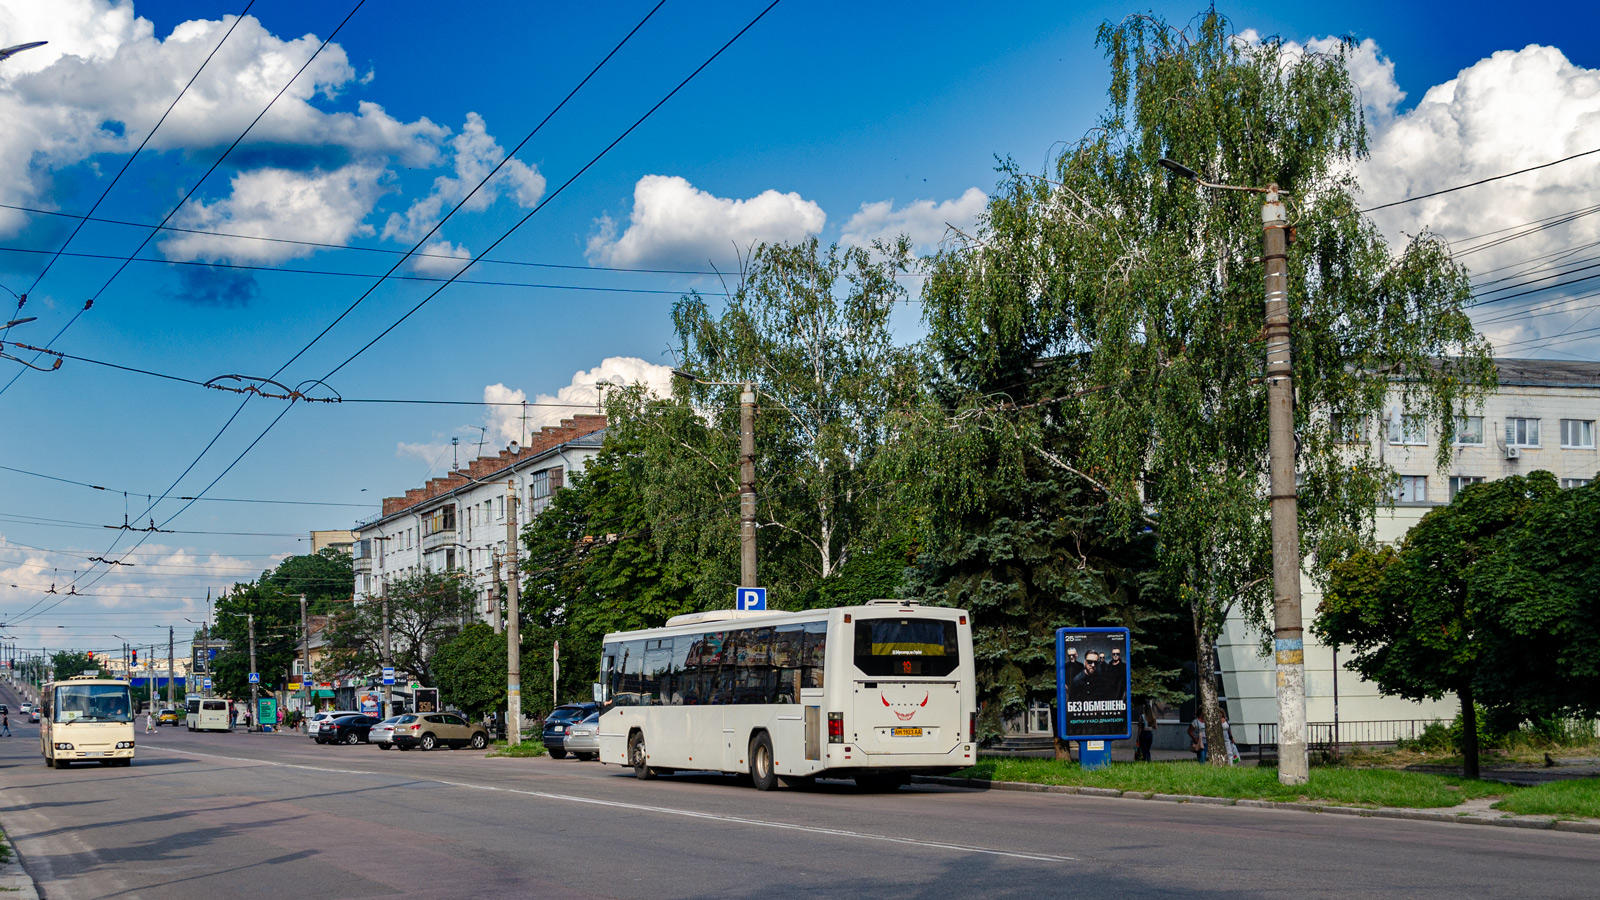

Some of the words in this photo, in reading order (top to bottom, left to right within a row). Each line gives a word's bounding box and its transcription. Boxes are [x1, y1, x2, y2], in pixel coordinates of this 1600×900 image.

[744, 591, 759, 610] P
[903, 661, 912, 673] 19
[1067, 701, 1082, 712] БЕЗ
